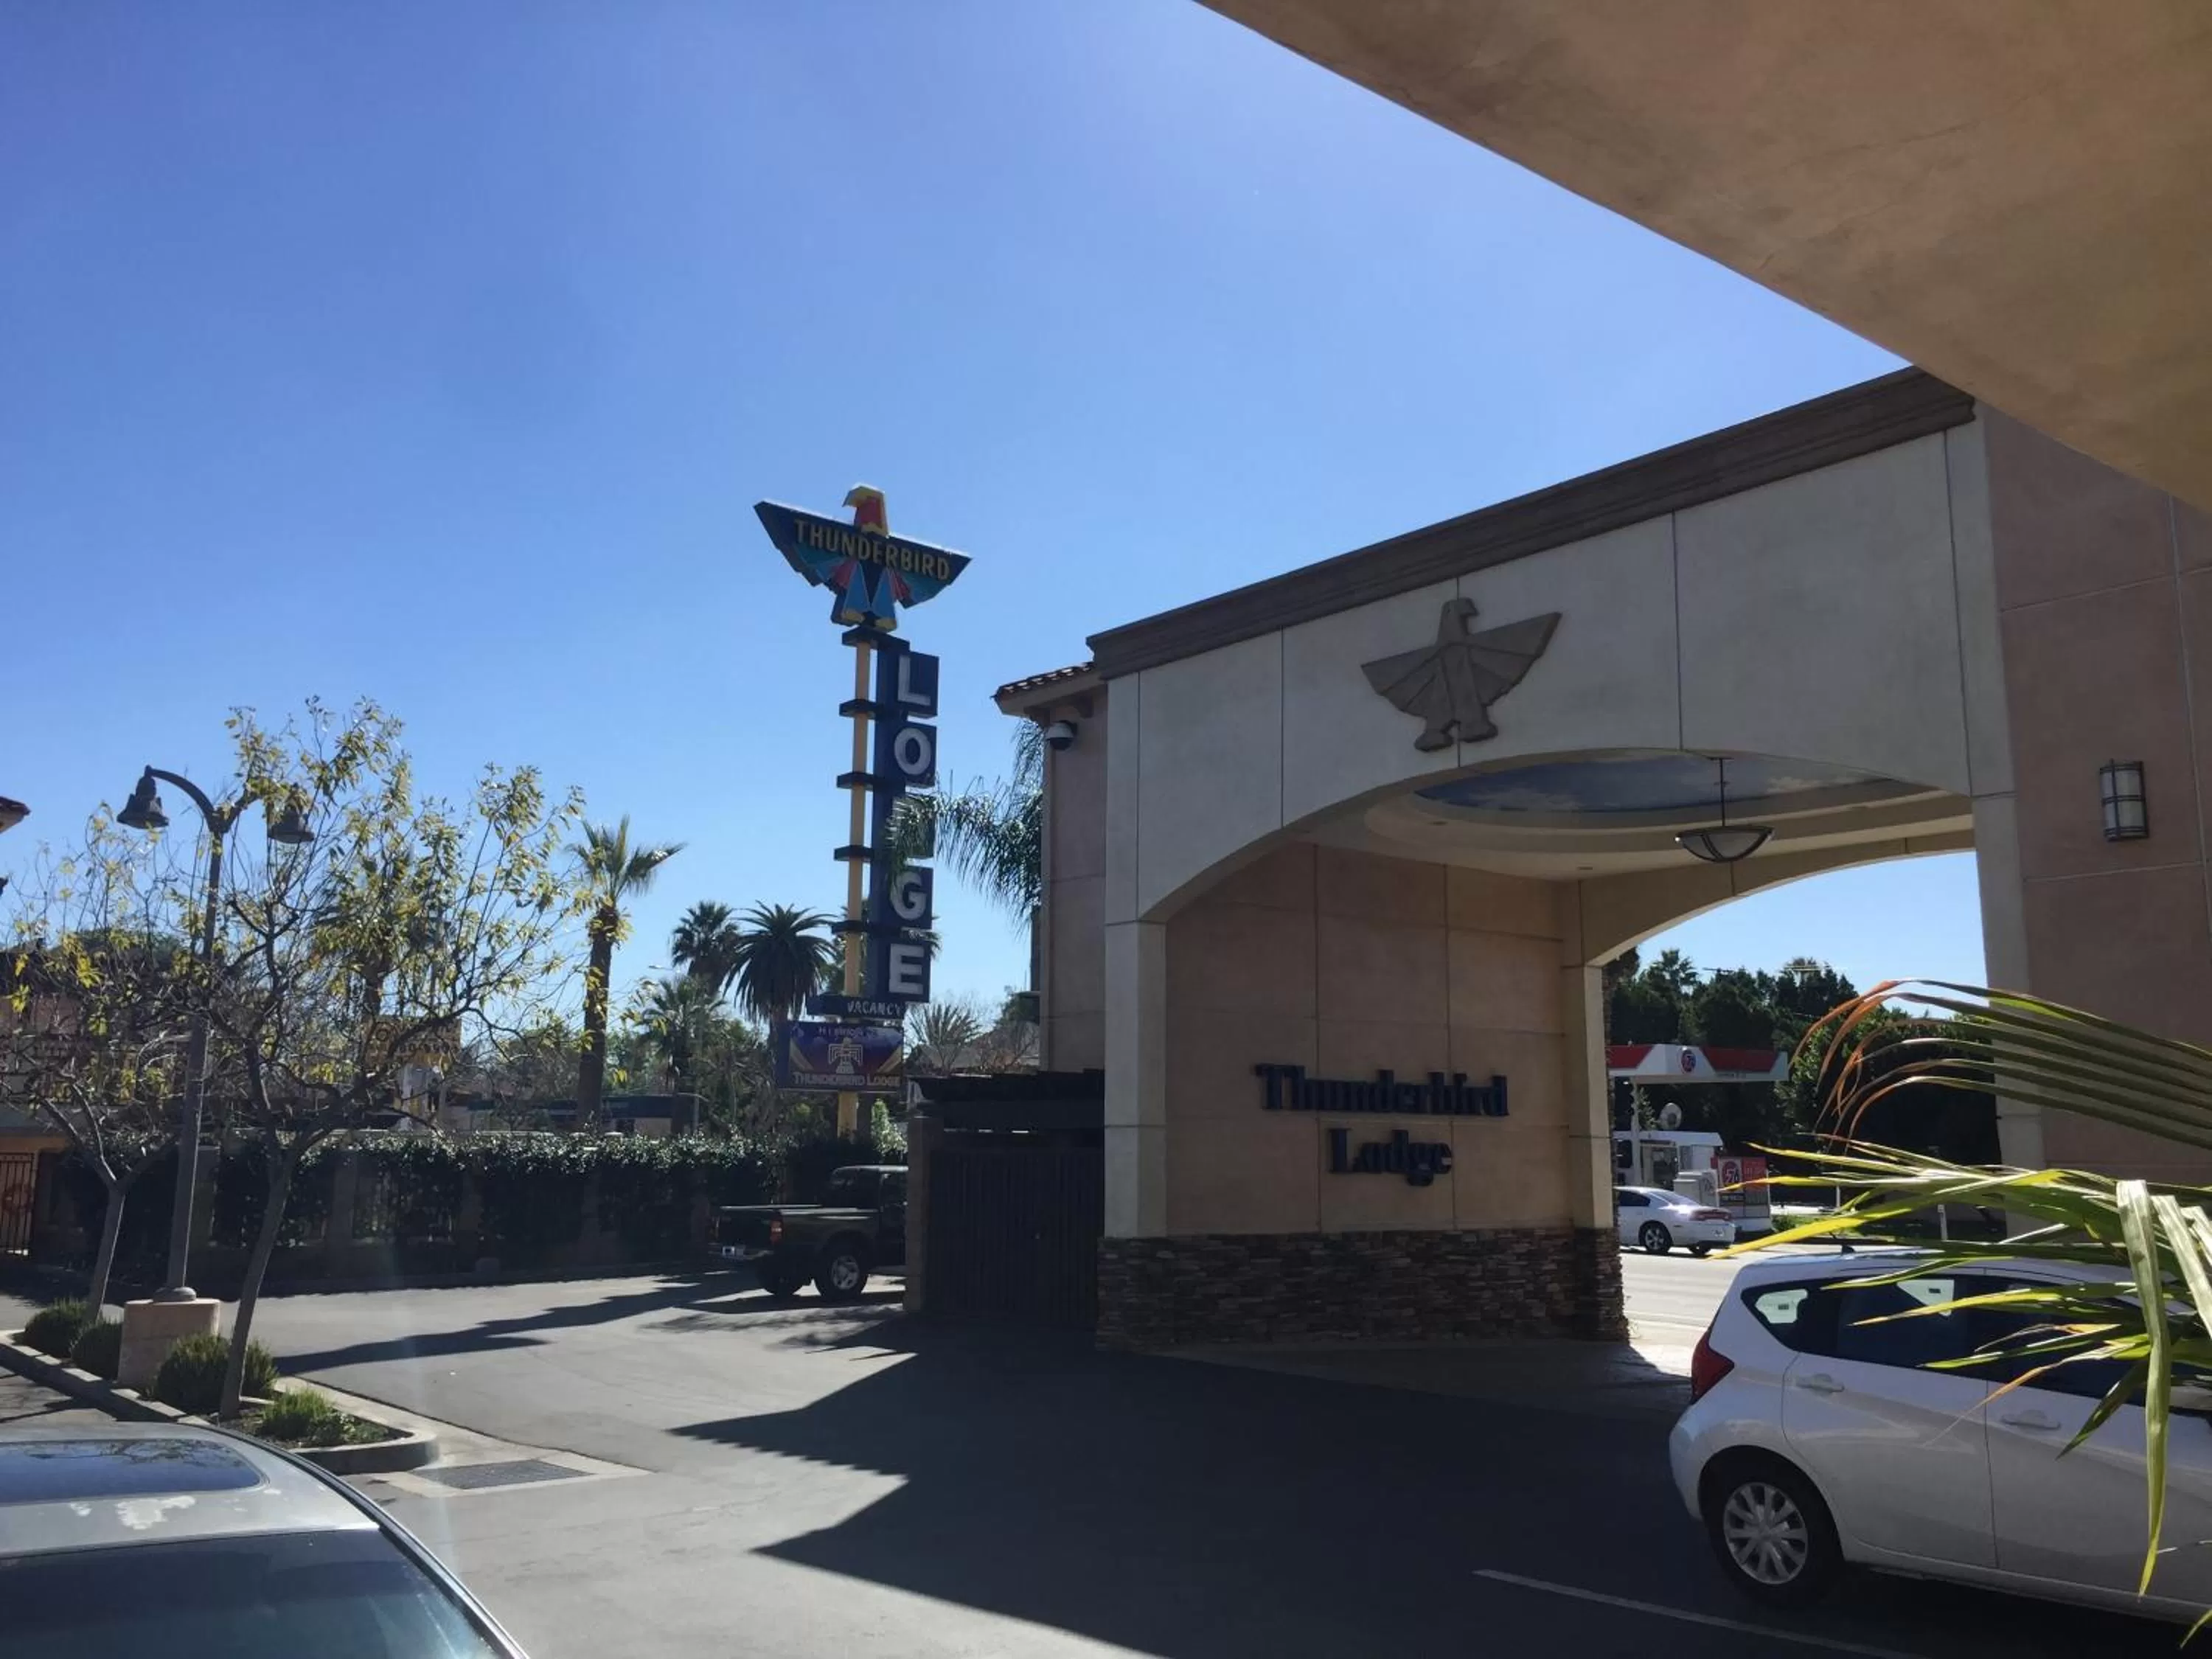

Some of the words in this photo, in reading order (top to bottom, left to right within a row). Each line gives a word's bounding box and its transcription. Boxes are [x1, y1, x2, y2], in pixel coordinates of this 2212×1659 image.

[793, 519, 950, 580] THUNDERBIRD
[888, 655, 931, 994] LOGE
[848, 1001, 901, 1015] VACANCY
[1253, 1064, 1509, 1116] Thunderbird
[1329, 1128, 1452, 1186] Lodge
